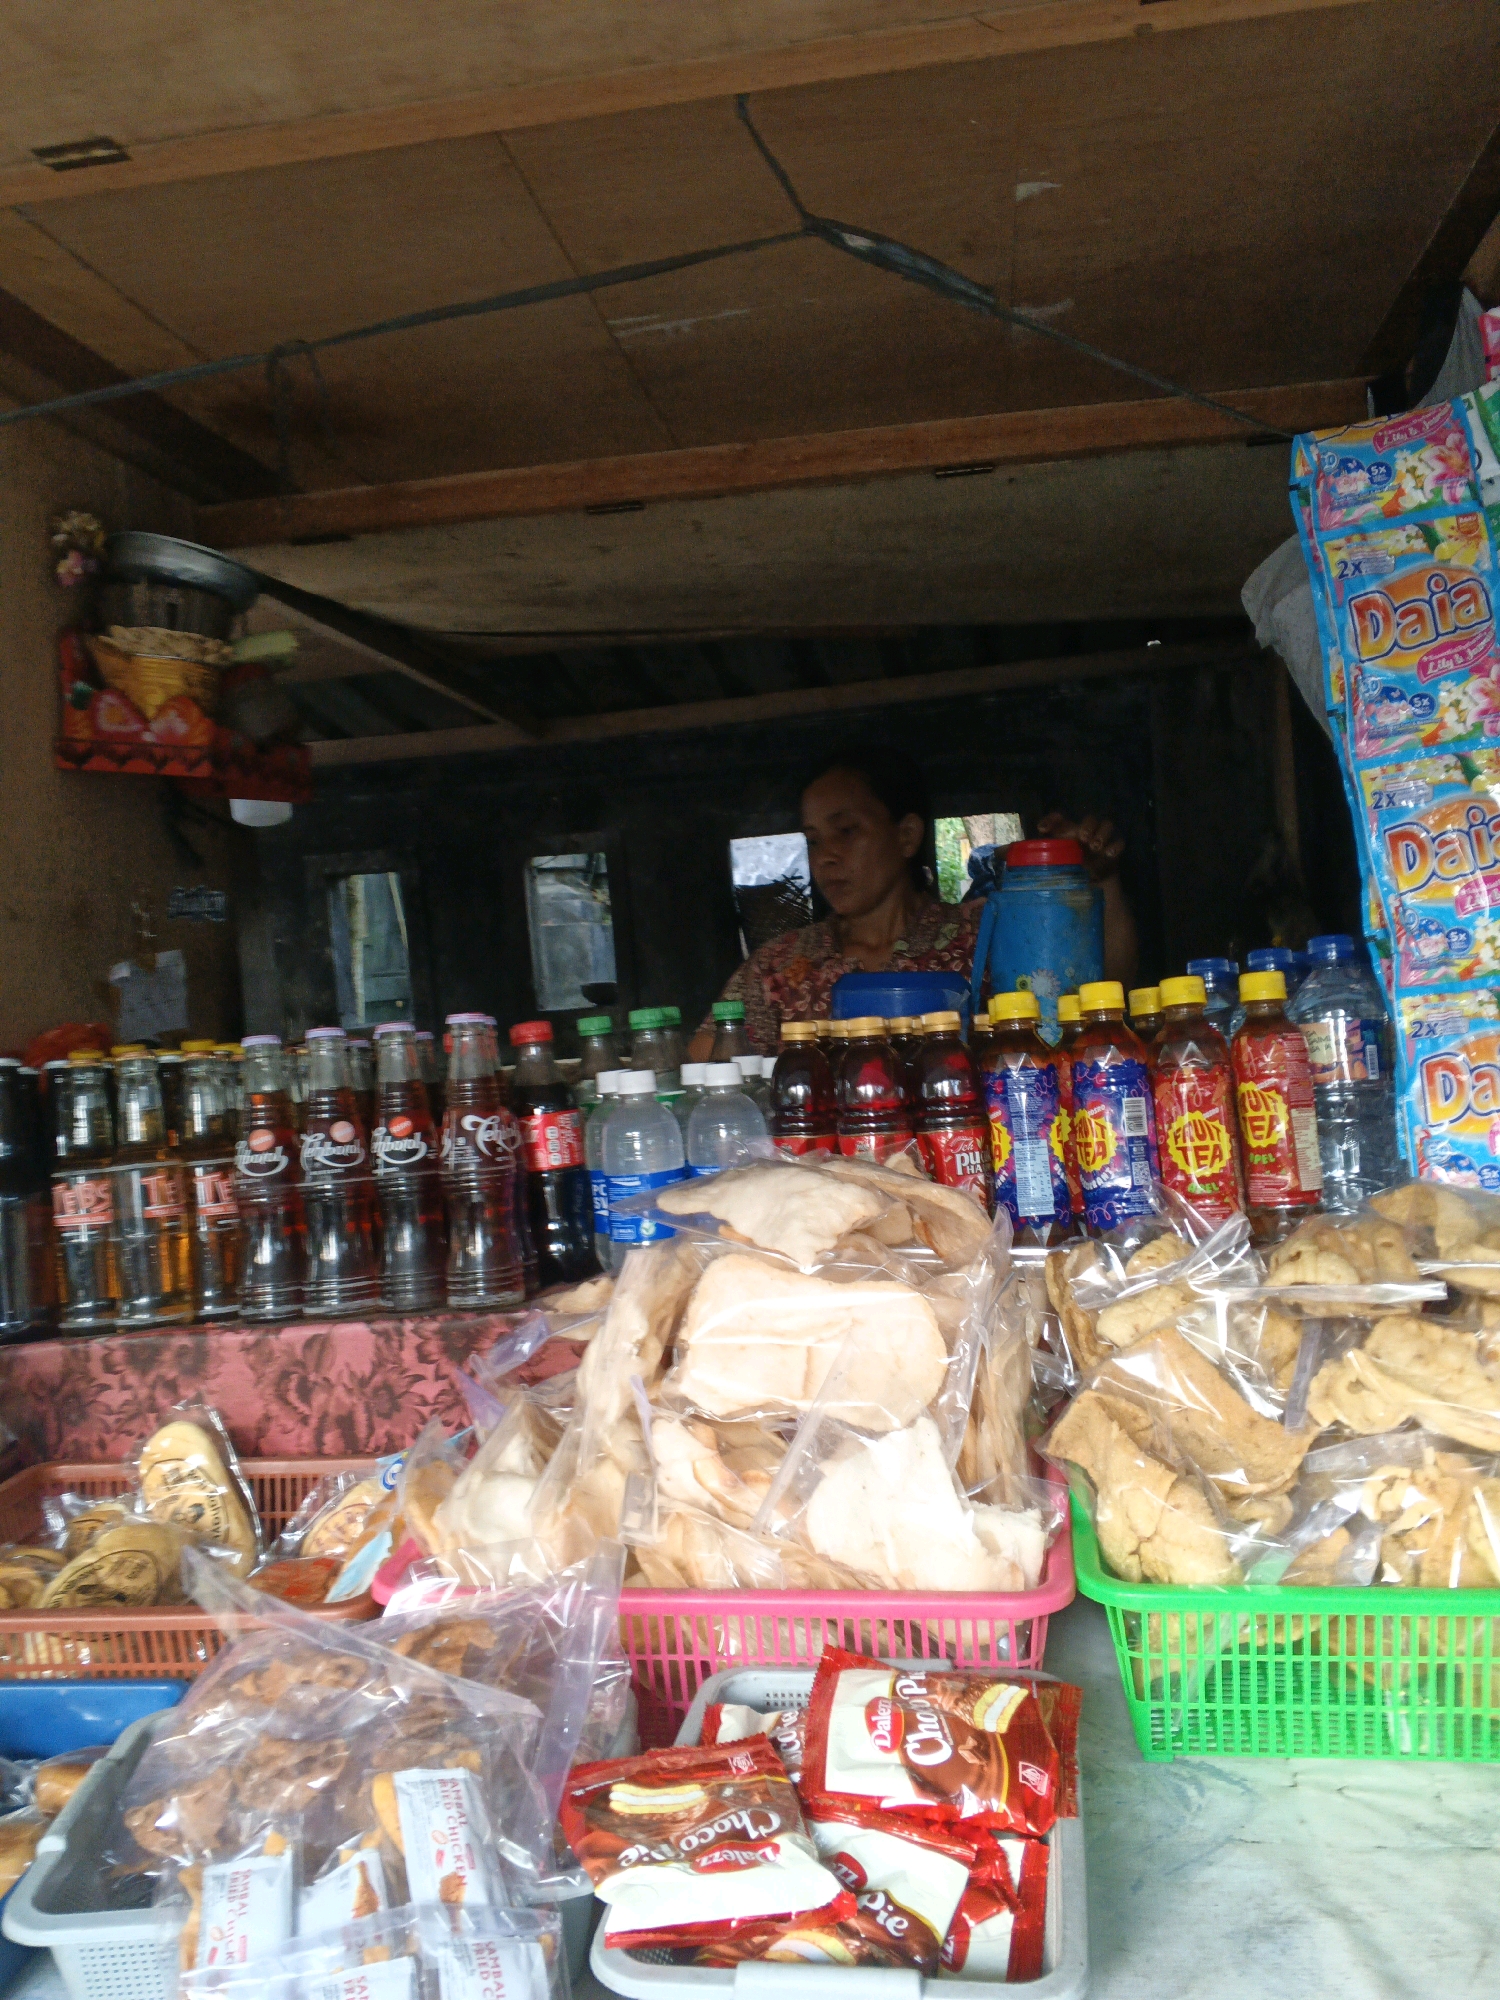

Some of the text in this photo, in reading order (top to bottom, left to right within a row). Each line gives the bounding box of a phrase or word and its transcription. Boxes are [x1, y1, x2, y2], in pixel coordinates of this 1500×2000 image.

[1349, 573, 1492, 663] Daia
[1239, 1089, 1280, 1113] RUIT
[1173, 1118, 1222, 1145] FRUIT
[1176, 1146, 1224, 1169] TEA
[895, 1671, 928, 1700] Pi
[449, 1778, 468, 1827] AMBAL
[447, 1815, 468, 1886] CHICKEN
[679, 1808, 781, 1852] Choco
[695, 1846, 782, 1867] Dalezz
[225, 1908, 237, 1965] CHICK
[857, 1891, 909, 1938] Pie
